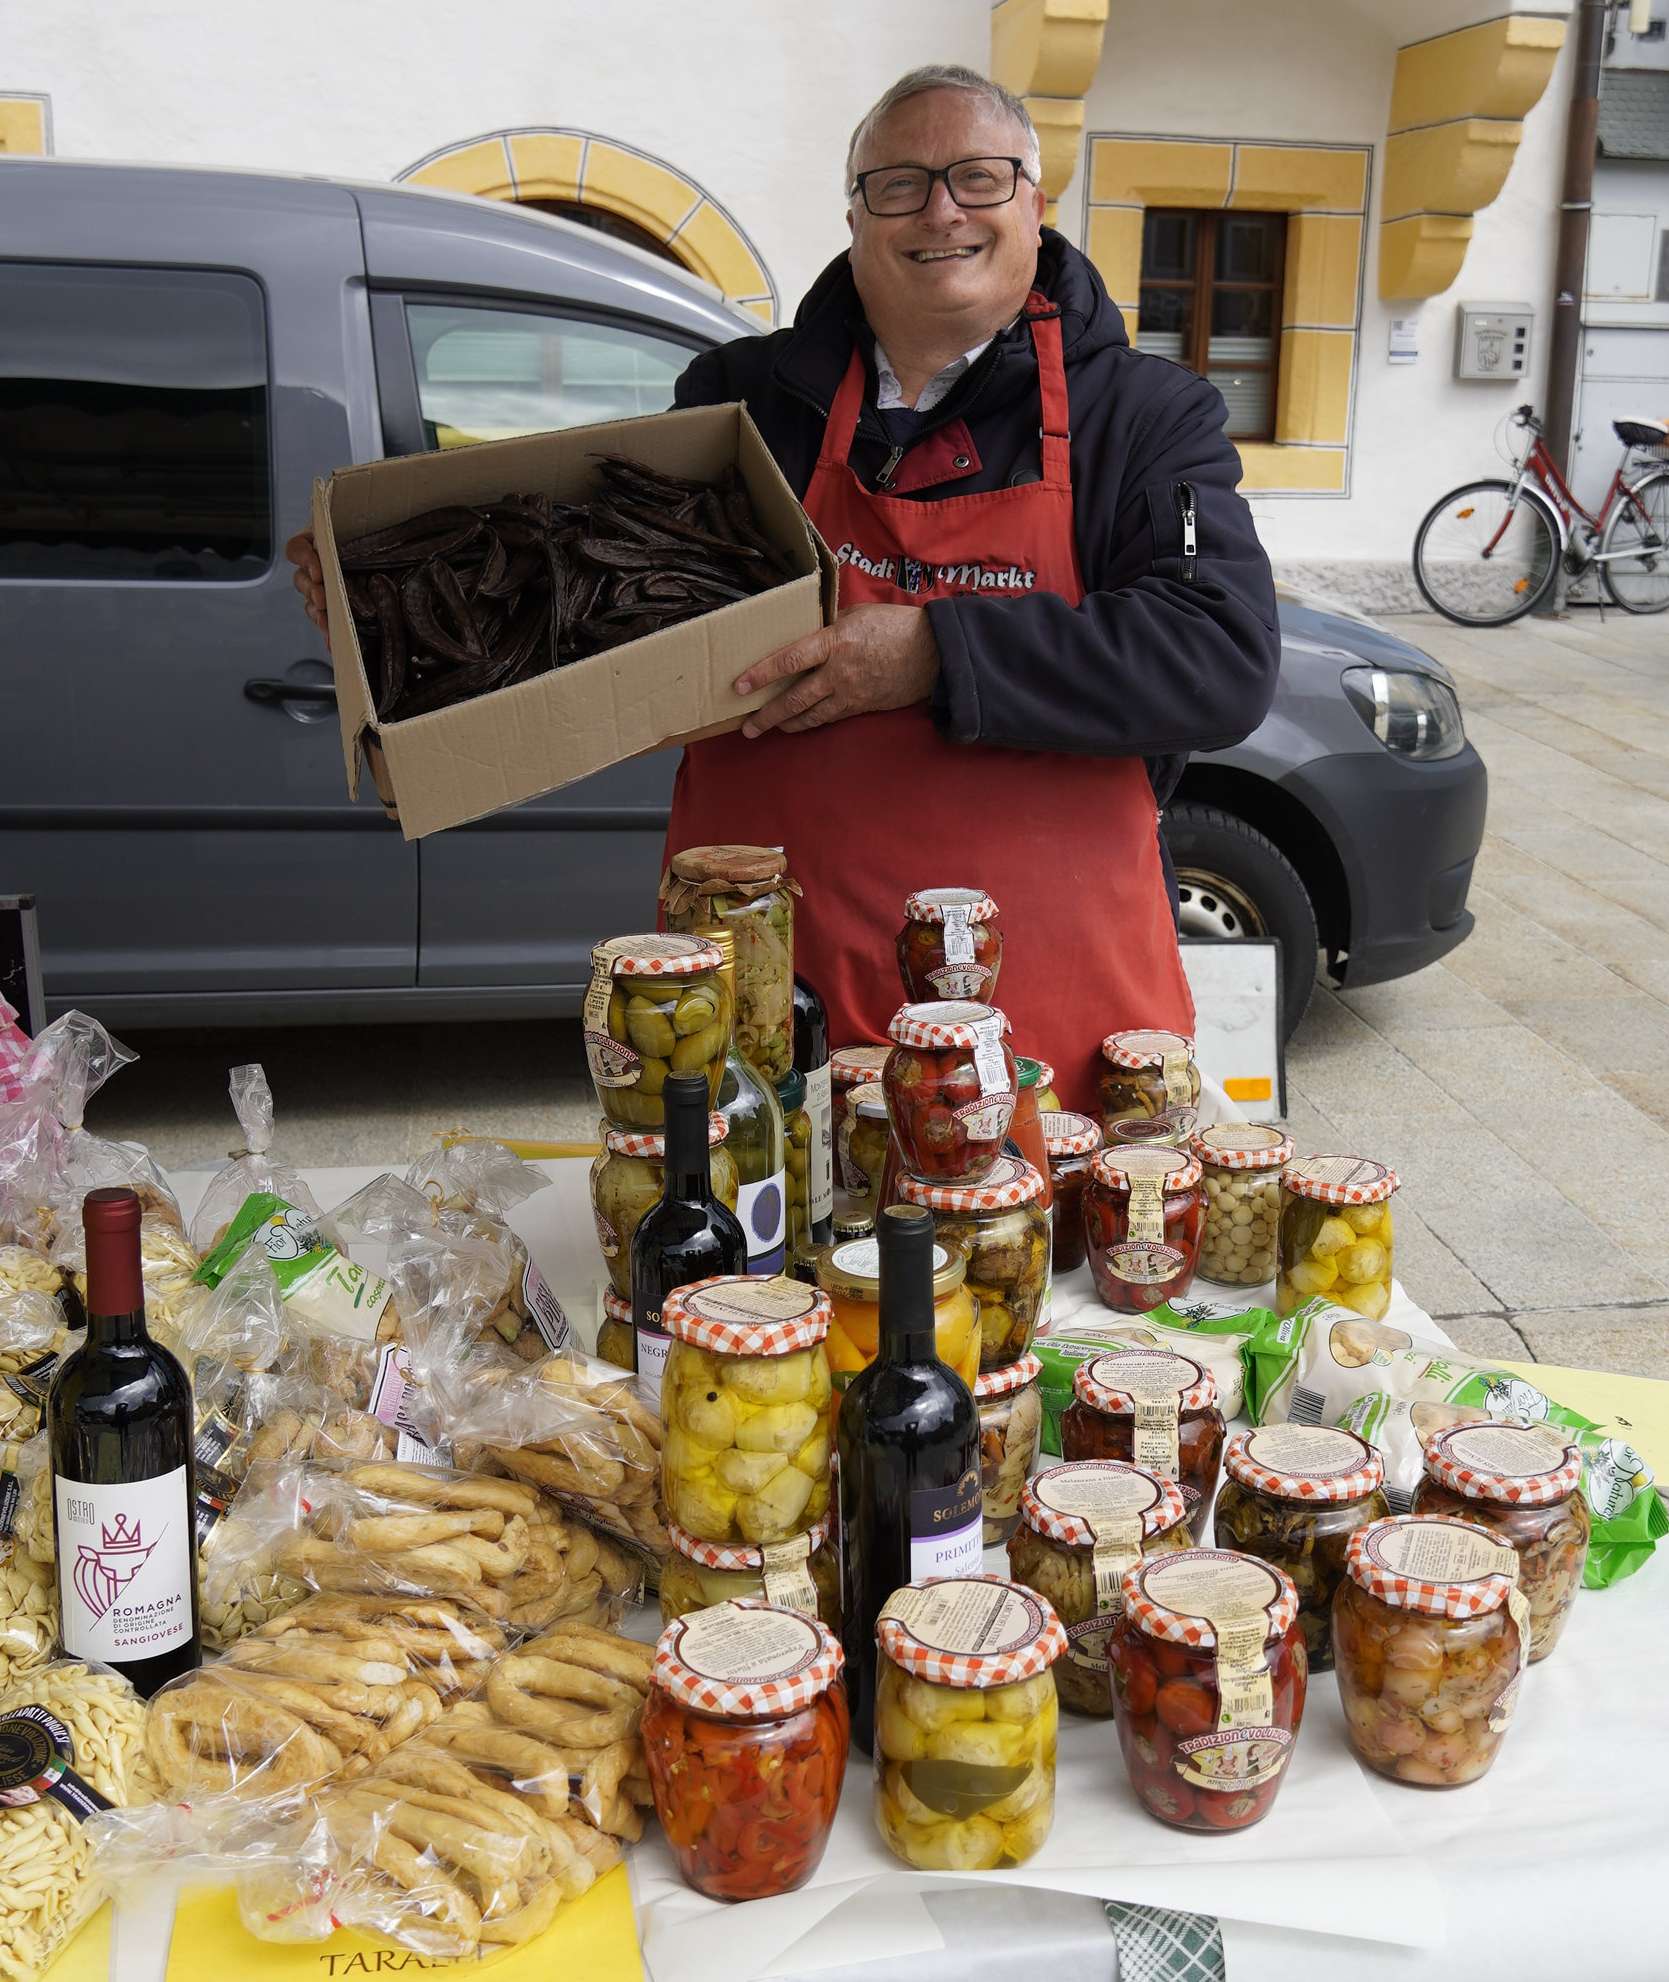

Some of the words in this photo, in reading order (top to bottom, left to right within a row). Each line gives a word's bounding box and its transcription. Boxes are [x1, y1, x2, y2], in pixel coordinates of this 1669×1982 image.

[836, 542, 896, 579] Stadt
[938, 563, 1035, 591] Markt
[646, 1310, 661, 1323] SO
[641, 1342, 668, 1359] NEGR
[67, 1498, 95, 1525] OSTRO
[113, 1594, 182, 1617] ROMAGNA
[113, 1606, 174, 1623] DENOMINAZIONE
[123, 1618, 155, 1628] ORIGINE
[114, 1620, 167, 1634] CONTROLLATA
[114, 1623, 184, 1647] SANGIOVESE
